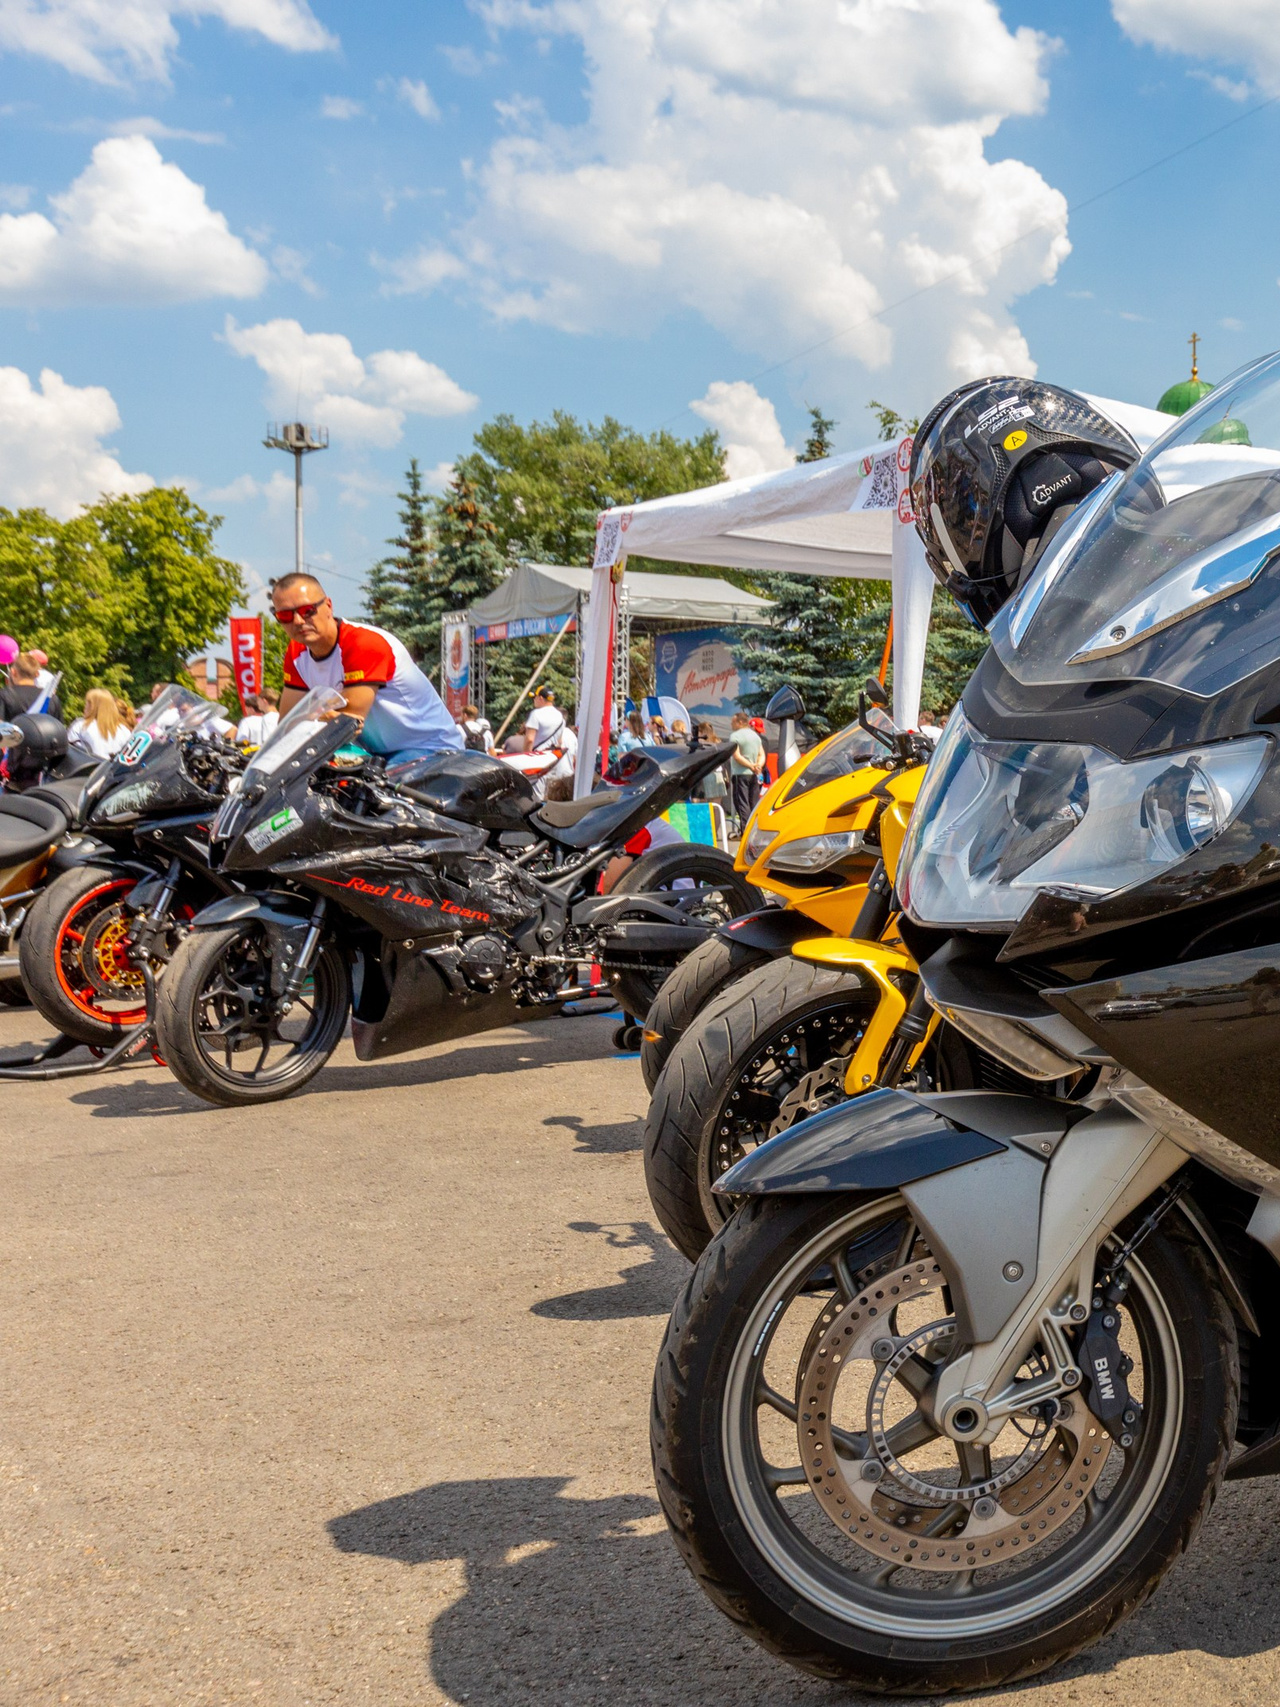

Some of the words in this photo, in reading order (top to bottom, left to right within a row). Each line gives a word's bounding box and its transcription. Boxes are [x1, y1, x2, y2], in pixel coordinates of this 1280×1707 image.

[1038, 473, 1073, 500] ADVANT
[347, 876, 390, 896] Red
[392, 889, 434, 908] Line
[440, 899, 490, 922] Team
[1094, 1357, 1115, 1399] BMW
